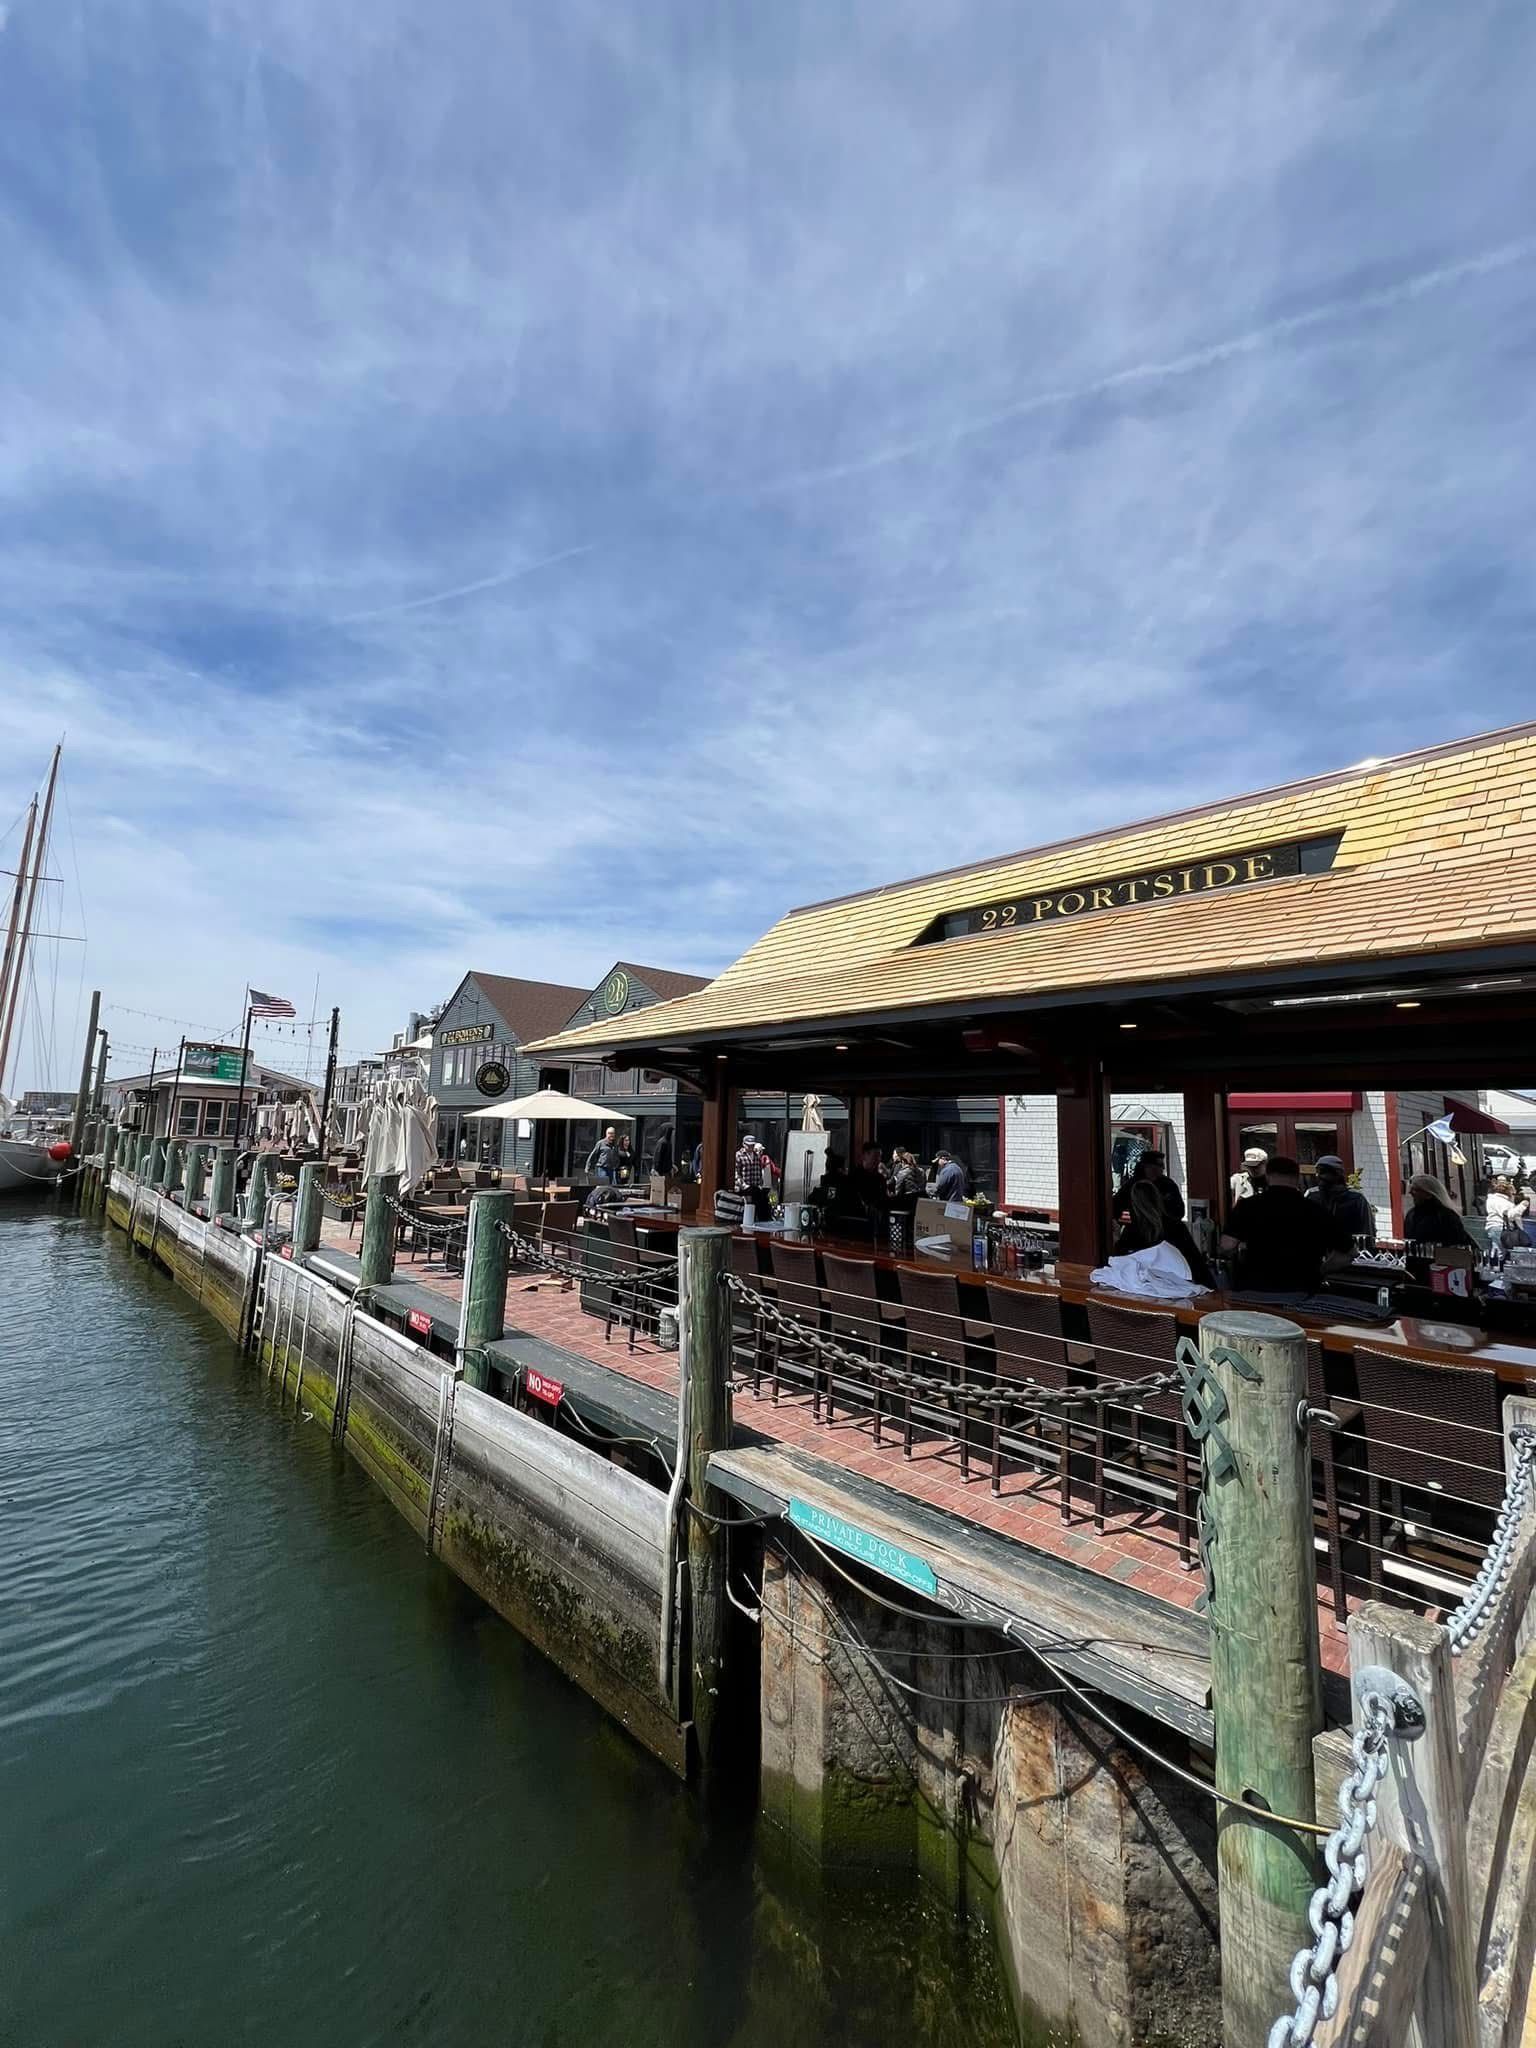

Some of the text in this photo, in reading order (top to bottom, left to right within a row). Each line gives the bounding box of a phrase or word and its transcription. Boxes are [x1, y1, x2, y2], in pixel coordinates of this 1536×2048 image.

[981, 854, 1276, 930] 22 PORTSIDE
[529, 1373, 541, 1392] NO
[811, 1510, 907, 1569] PRIVATE DOCK
